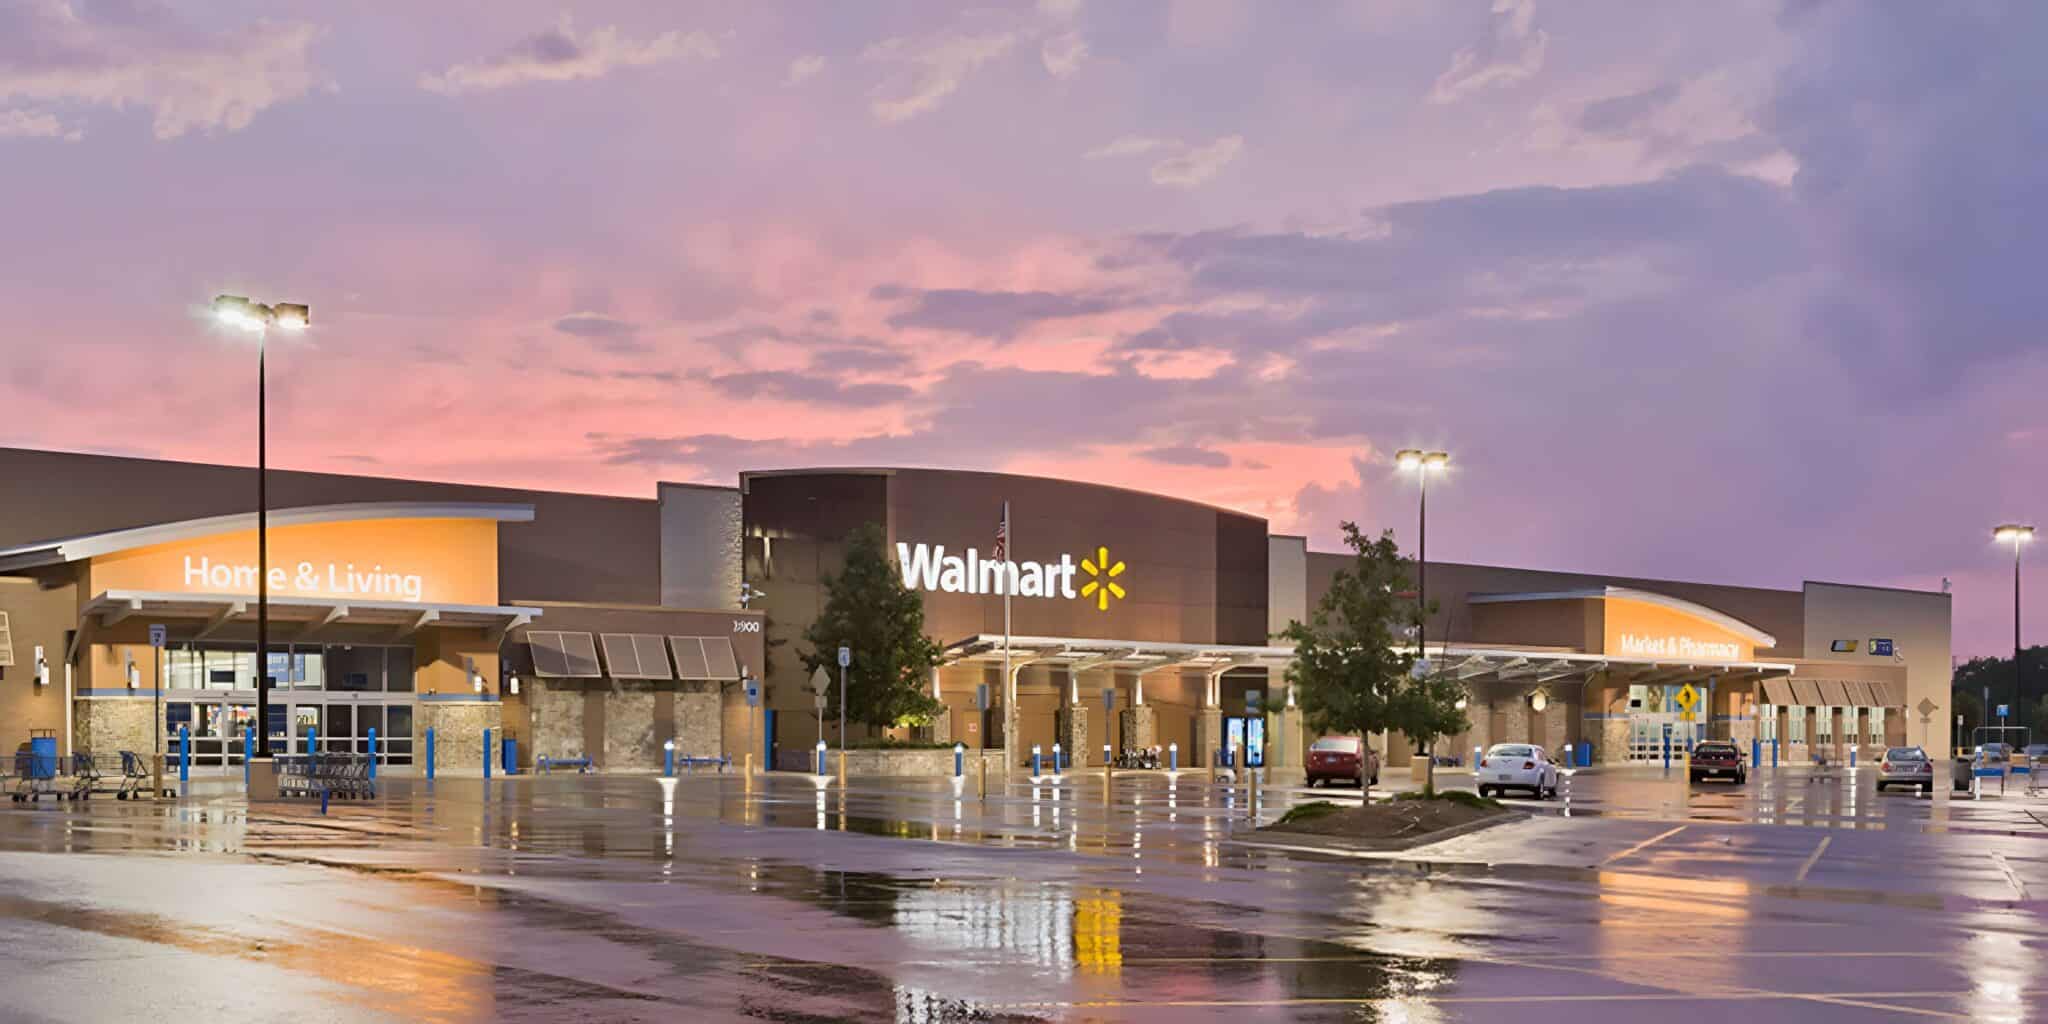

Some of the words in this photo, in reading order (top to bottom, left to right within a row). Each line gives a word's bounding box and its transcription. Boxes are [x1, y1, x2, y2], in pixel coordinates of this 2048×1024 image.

[183, 555, 288, 590] Home
[294, 561, 320, 592] &
[328, 563, 422, 602] Living
[896, 542, 1077, 599] Walmart
